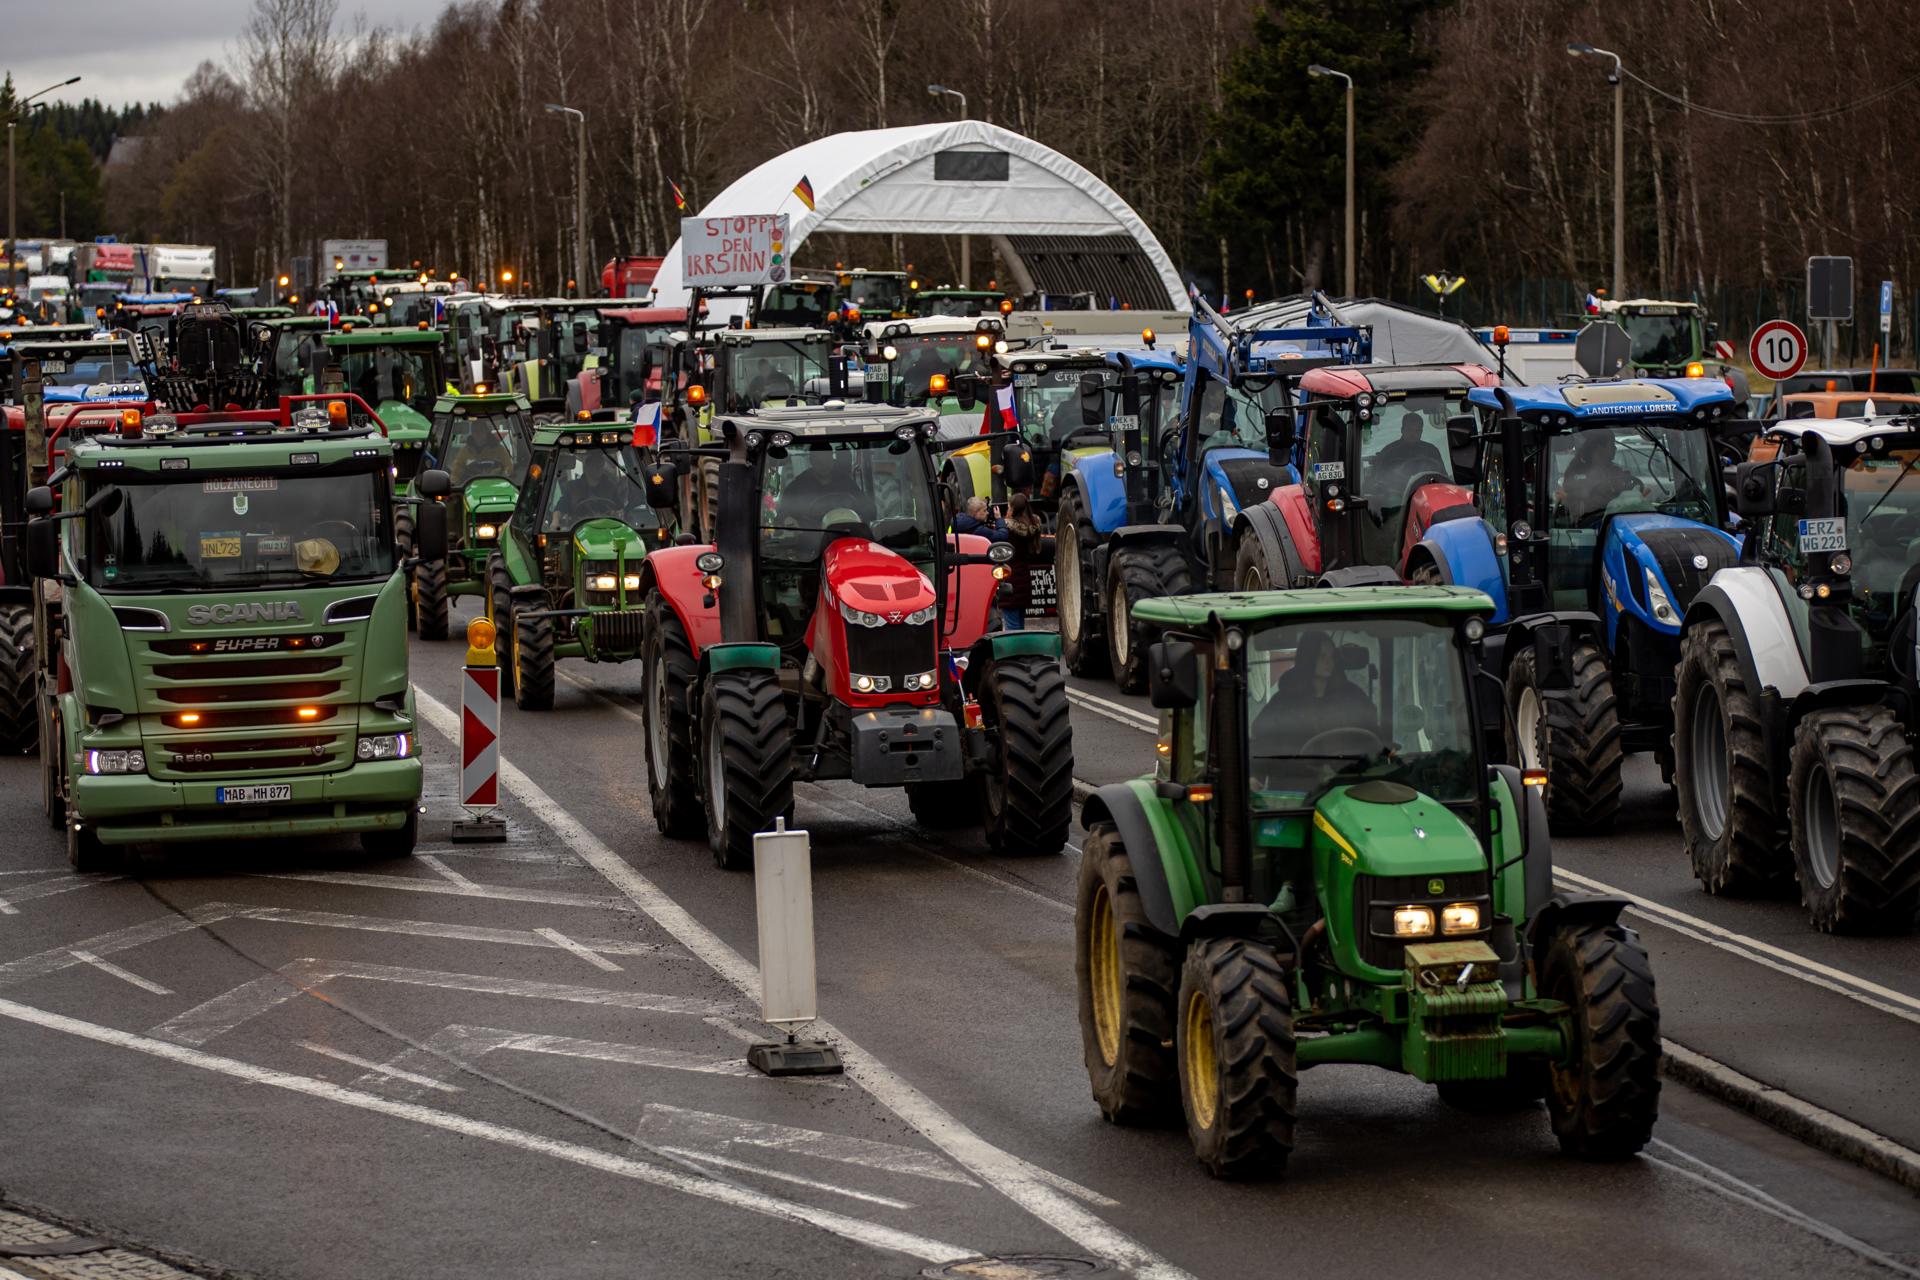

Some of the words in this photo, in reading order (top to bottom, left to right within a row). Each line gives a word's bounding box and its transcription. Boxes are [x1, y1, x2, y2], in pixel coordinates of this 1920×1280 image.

[705, 216, 778, 236] STOPPT
[722, 237, 752, 253] DEN
[687, 251, 765, 276] IRRSINN
[1883, 286, 1890, 310] P
[1766, 337, 1793, 363] 10
[869, 365, 882, 373] MAB
[1586, 404, 1643, 415] LANDTECHNIK
[1644, 403, 1678, 413] LORENZ
[1320, 463, 1335, 471] ERZ
[206, 477, 274, 490] HOLZKNECHT
[1807, 521, 1836, 535] ERZ
[187, 601, 304, 625] SCANIA
[214, 638, 279, 651] SUPER
[175, 755, 184, 763] R
[224, 788, 246, 801] MAB
[253, 787, 268, 799] MH
[269, 786, 290, 798] 877
